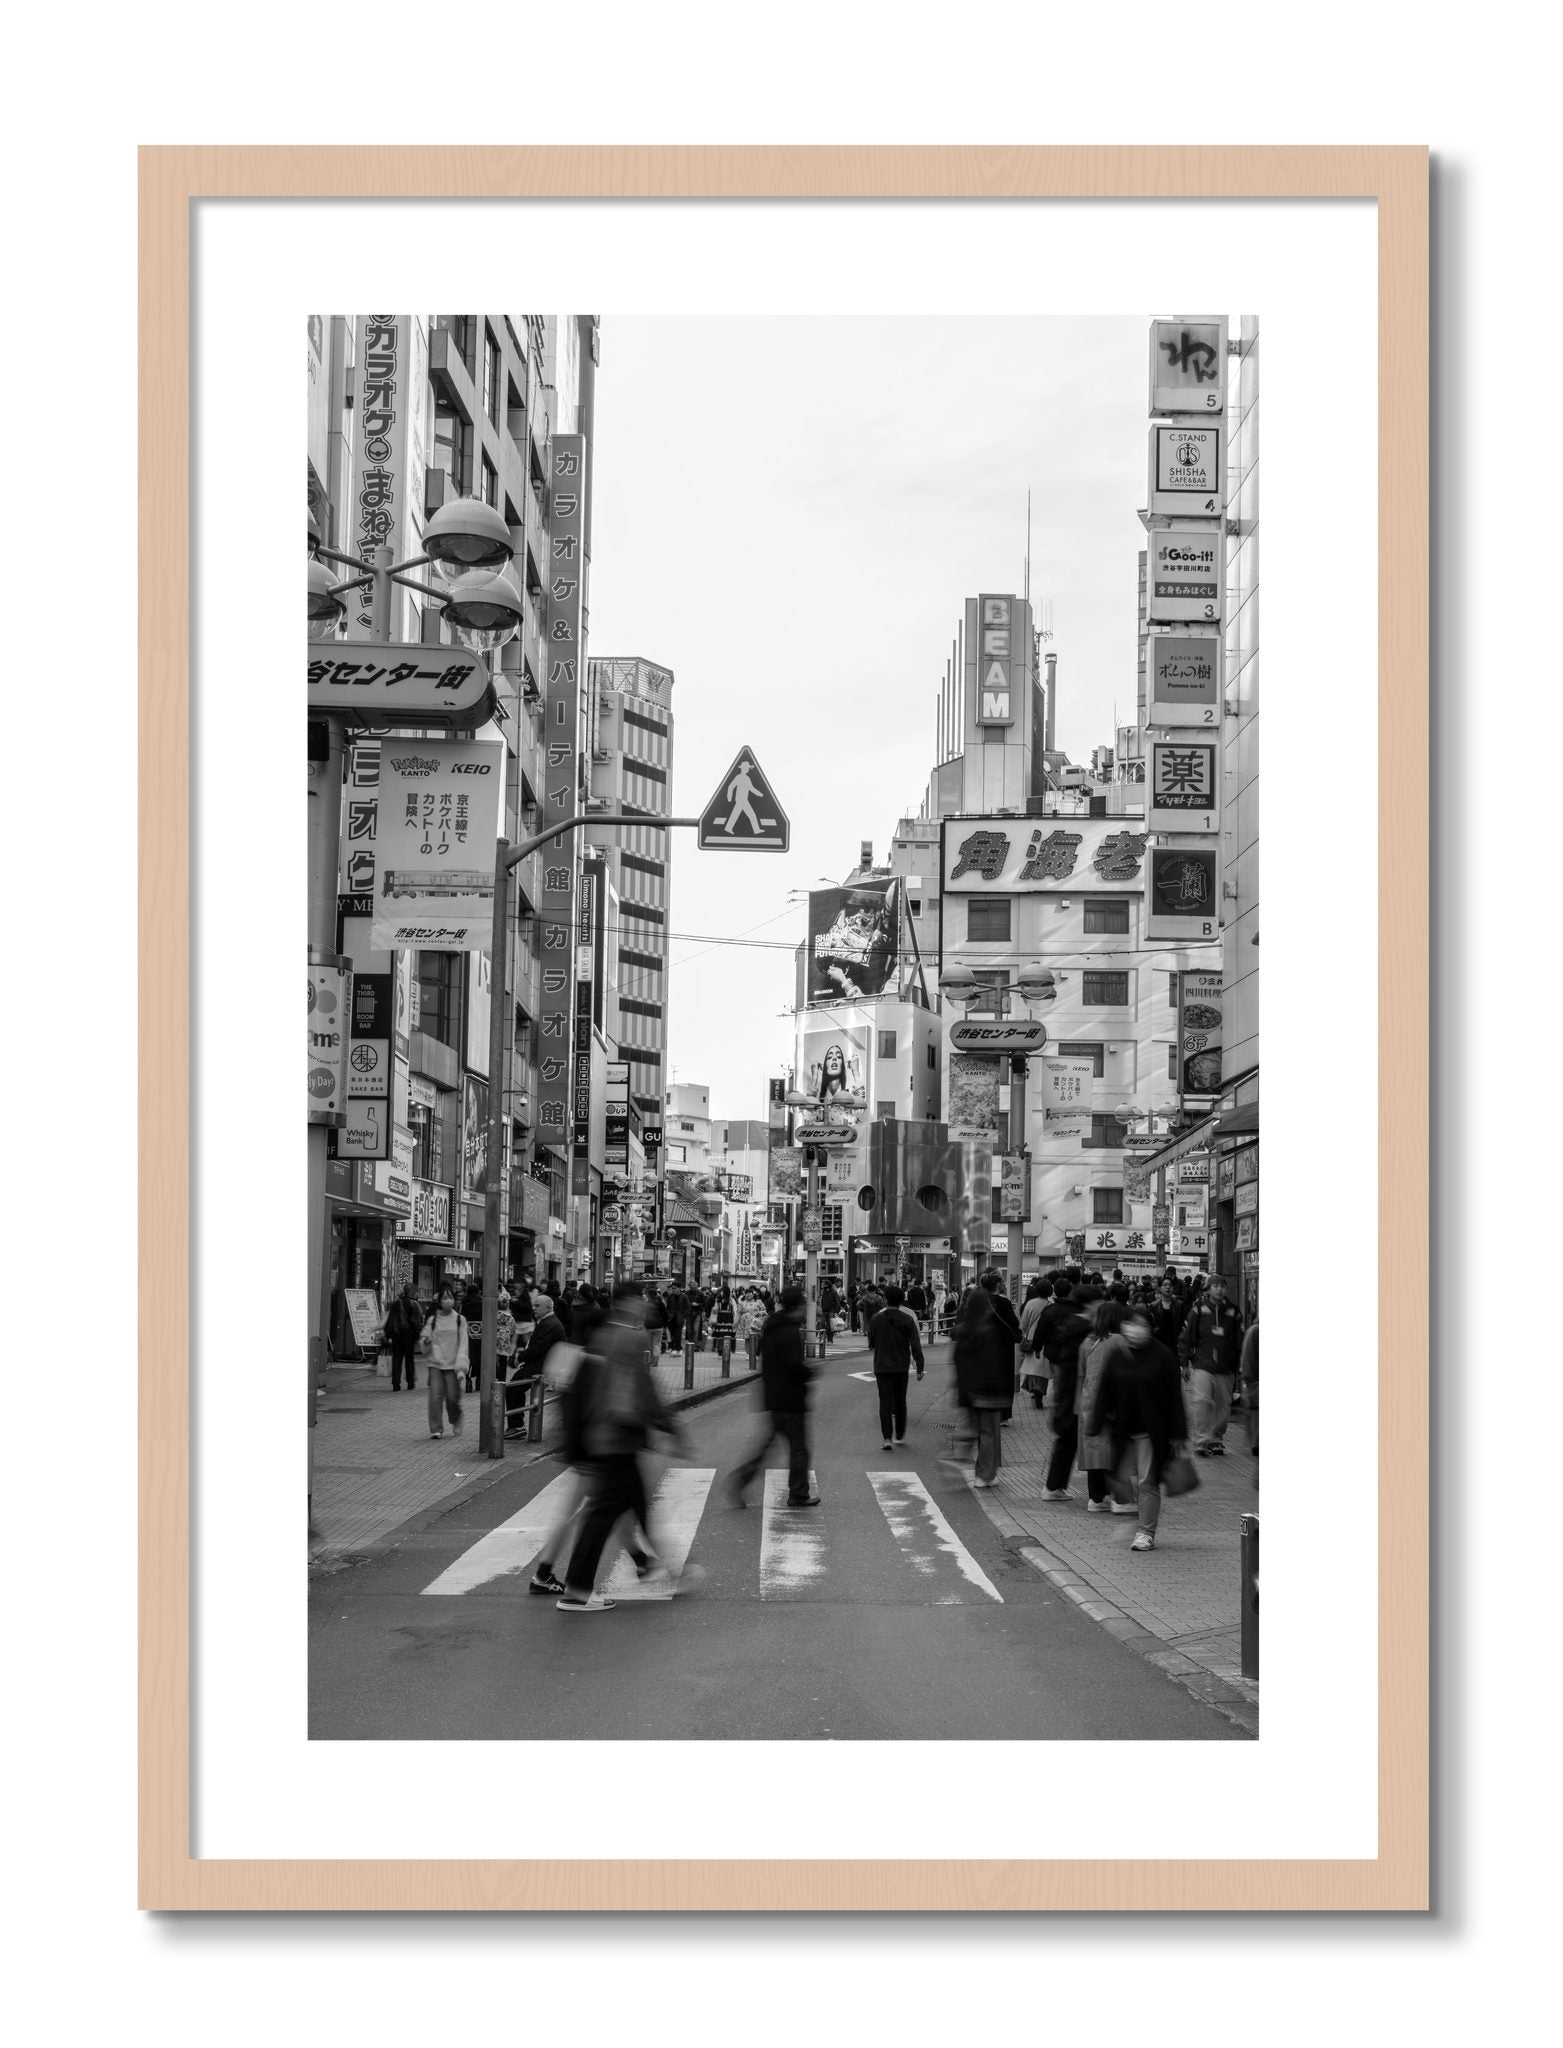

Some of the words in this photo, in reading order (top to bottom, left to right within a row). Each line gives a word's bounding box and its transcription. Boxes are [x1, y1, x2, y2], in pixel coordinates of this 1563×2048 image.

[363, 323, 397, 439] カラオケ
[1206, 394, 1217, 407] 5
[1169, 433, 1207, 442] C.STAND
[1169, 467, 1207, 476] SHISHA
[1169, 476, 1207, 484] CAFE&BAR
[1205, 499, 1216, 512] 4
[1204, 604, 1215, 618] 3
[982, 598, 1010, 719] BEAM
[1203, 709, 1214, 723] 2
[450, 763, 492, 775] KEIO
[1161, 750, 1204, 792] 薬
[405, 793, 419, 829] 冒険へ
[420, 793, 435, 855] カントーの
[454, 793, 470, 844] 京王線で
[1203, 815, 1211, 829] 1
[950, 829, 1149, 881] 角海老
[1157, 862, 1208, 902] 一蘭
[582, 878, 590, 909] kimono
[394, 927, 468, 939] 渋谷センター街
[581, 911, 589, 942] hearts
[1202, 922, 1213, 936] B
[539, 925, 569, 1127] カラオケ館
[956, 1028, 1041, 1039] 渋谷センター街
[1184, 1035, 1208, 1052] 6F
[346, 1129, 375, 1139] Whisky
[346, 1136, 363, 1145] Bank
[644, 1132, 662, 1142] GU
[1096, 1231, 1146, 1249] 兆楽
